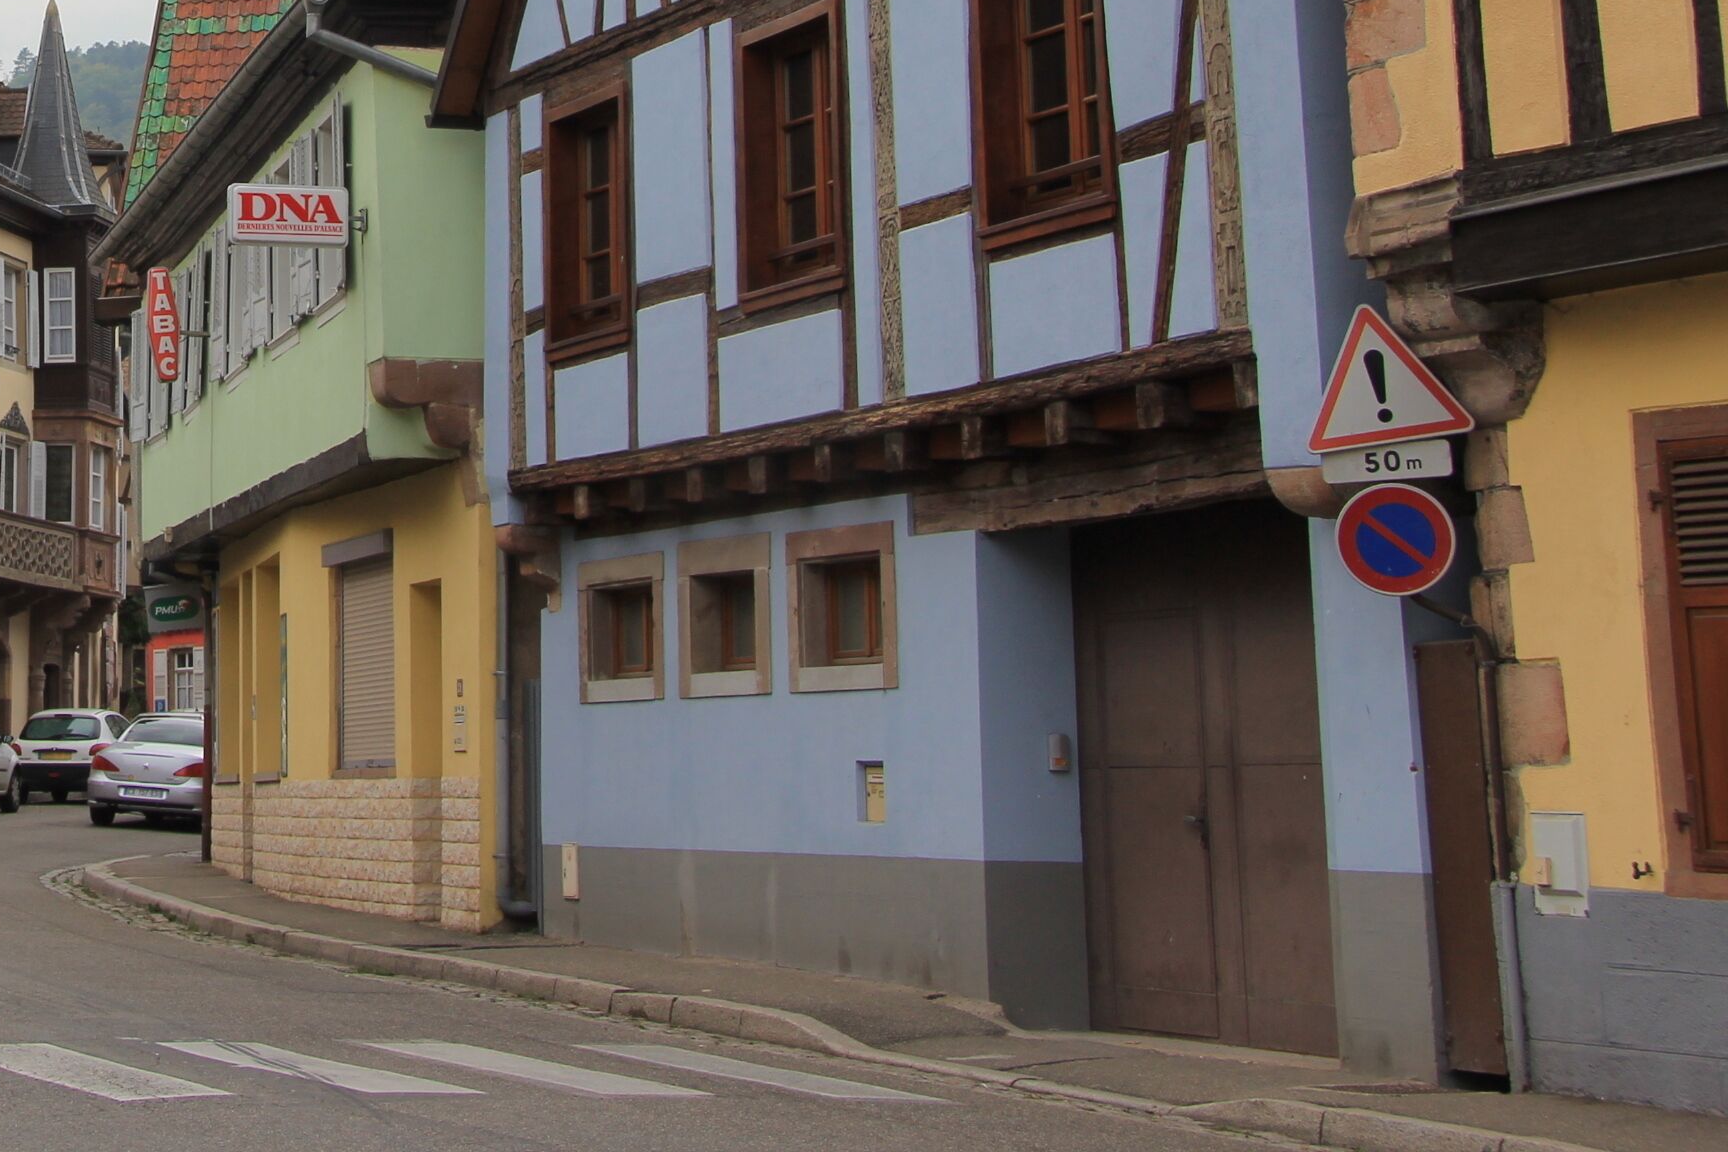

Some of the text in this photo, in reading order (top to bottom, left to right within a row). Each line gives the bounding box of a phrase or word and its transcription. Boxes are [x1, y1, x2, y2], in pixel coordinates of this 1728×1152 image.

[237, 192, 343, 224] DNA
[275, 224, 313, 232] NOUVELLES
[314, 225, 344, 233] D'ALSACE
[152, 271, 176, 376] TABAC
[1365, 450, 1422, 473] 50 m
